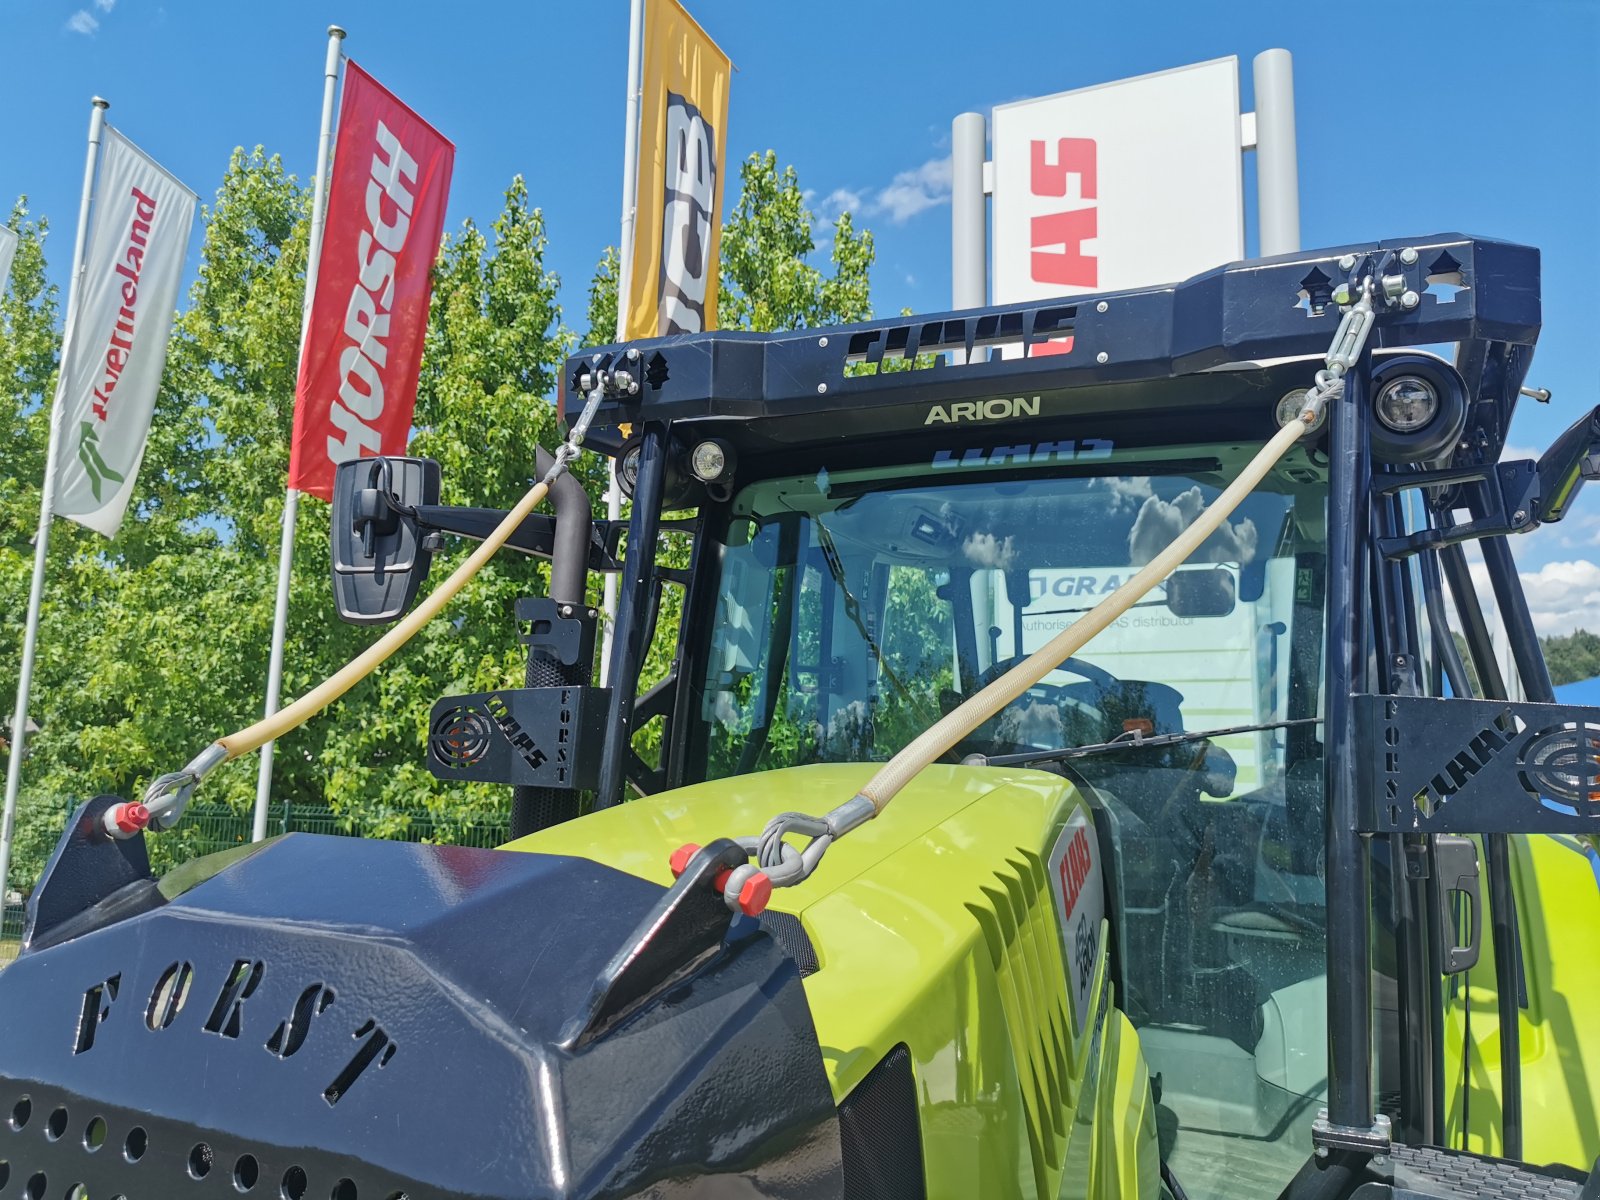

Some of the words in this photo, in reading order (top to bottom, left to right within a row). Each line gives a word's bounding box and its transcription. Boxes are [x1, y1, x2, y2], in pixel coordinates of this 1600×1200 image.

[92, 186, 157, 423] Kverneland
[327, 119, 419, 466] HORSCH
[843, 306, 1078, 379] CLAAS
[924, 396, 1041, 425] ARION
[484, 694, 548, 770] CLAAS
[1413, 707, 1527, 819] CLAAS
[1059, 825, 1091, 921] CLAAS
[73, 959, 397, 1107] FORST
